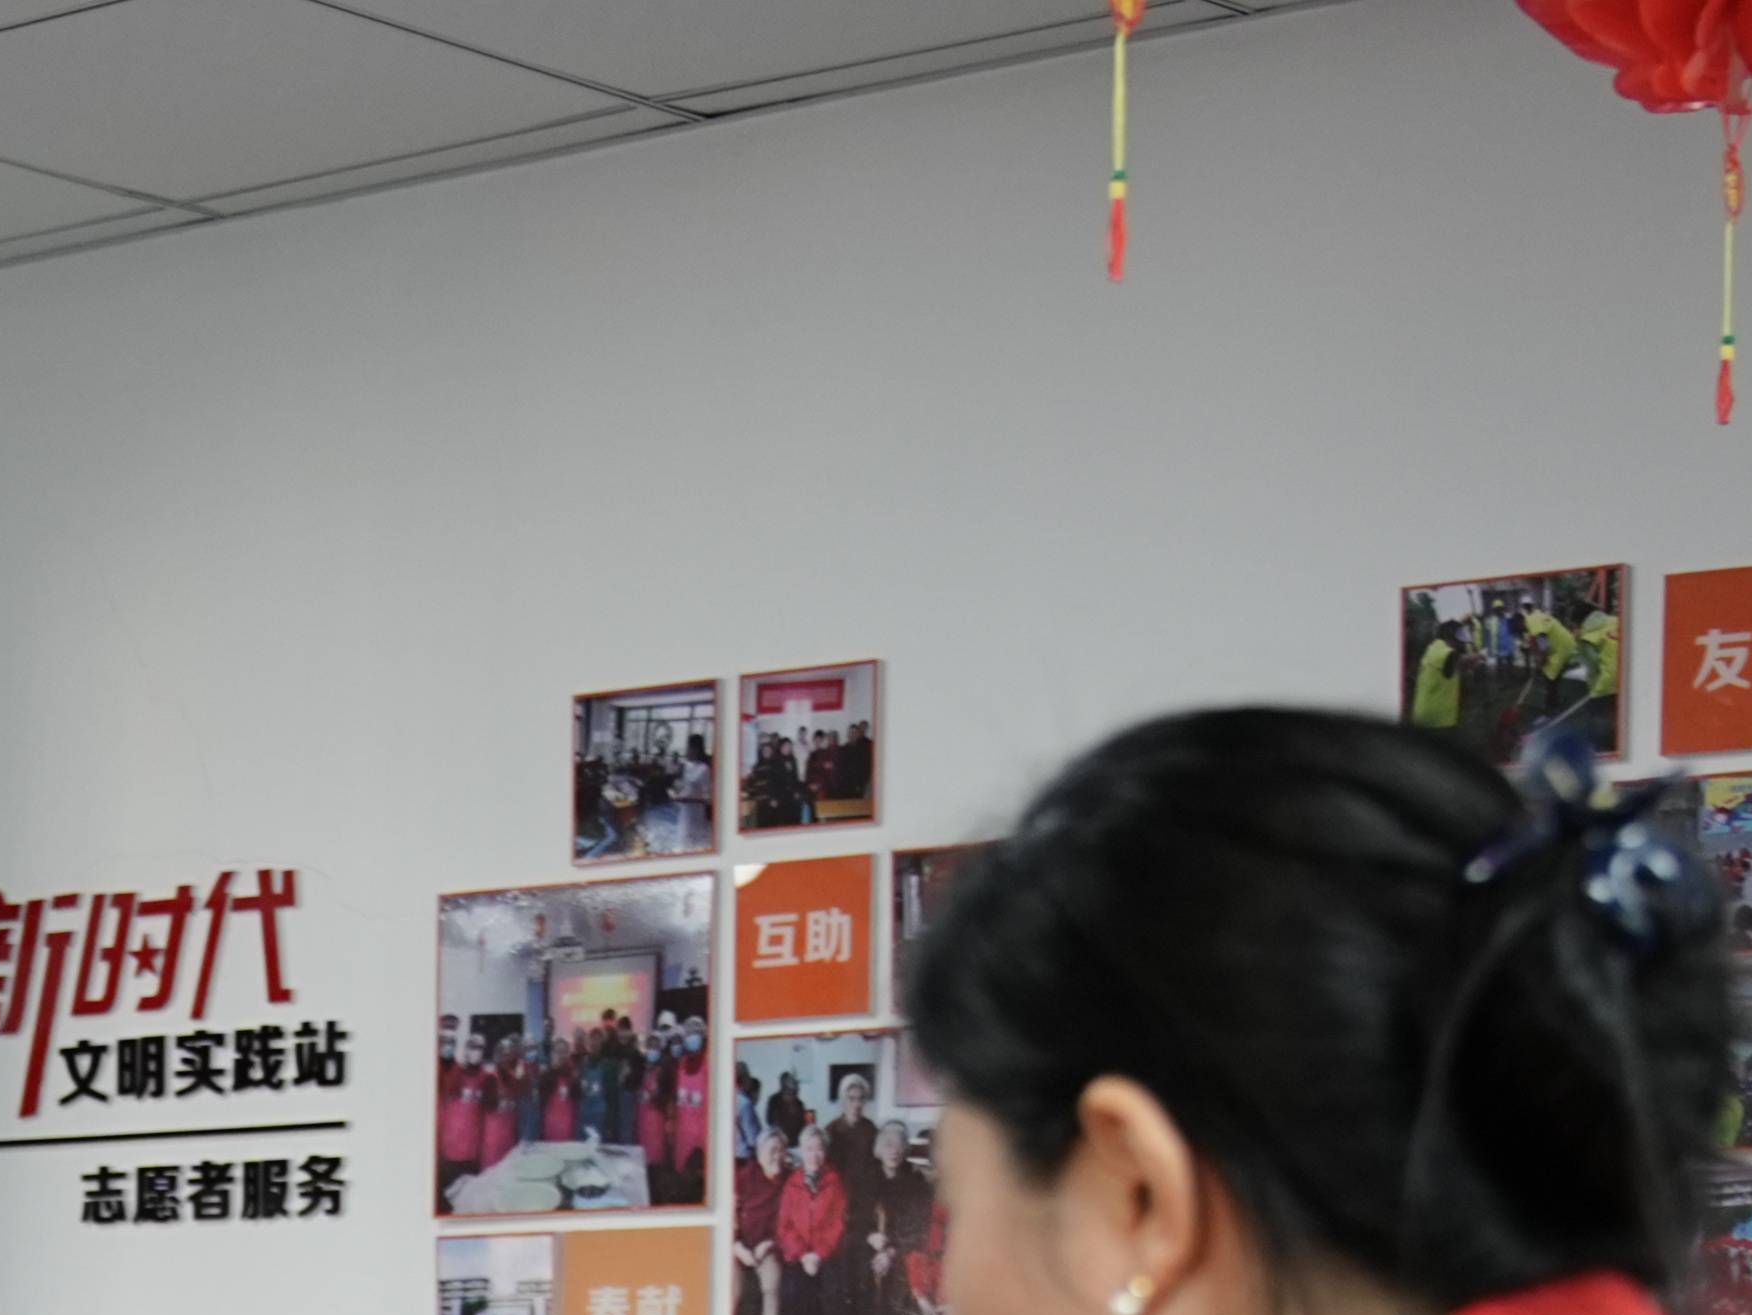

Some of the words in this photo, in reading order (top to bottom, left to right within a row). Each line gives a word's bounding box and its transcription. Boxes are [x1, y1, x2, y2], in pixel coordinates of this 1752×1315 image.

[752, 905, 853, 969] 互助
[58, 1020, 350, 1106] 文明实践站
[80, 1154, 348, 1226] 志愿者服务
